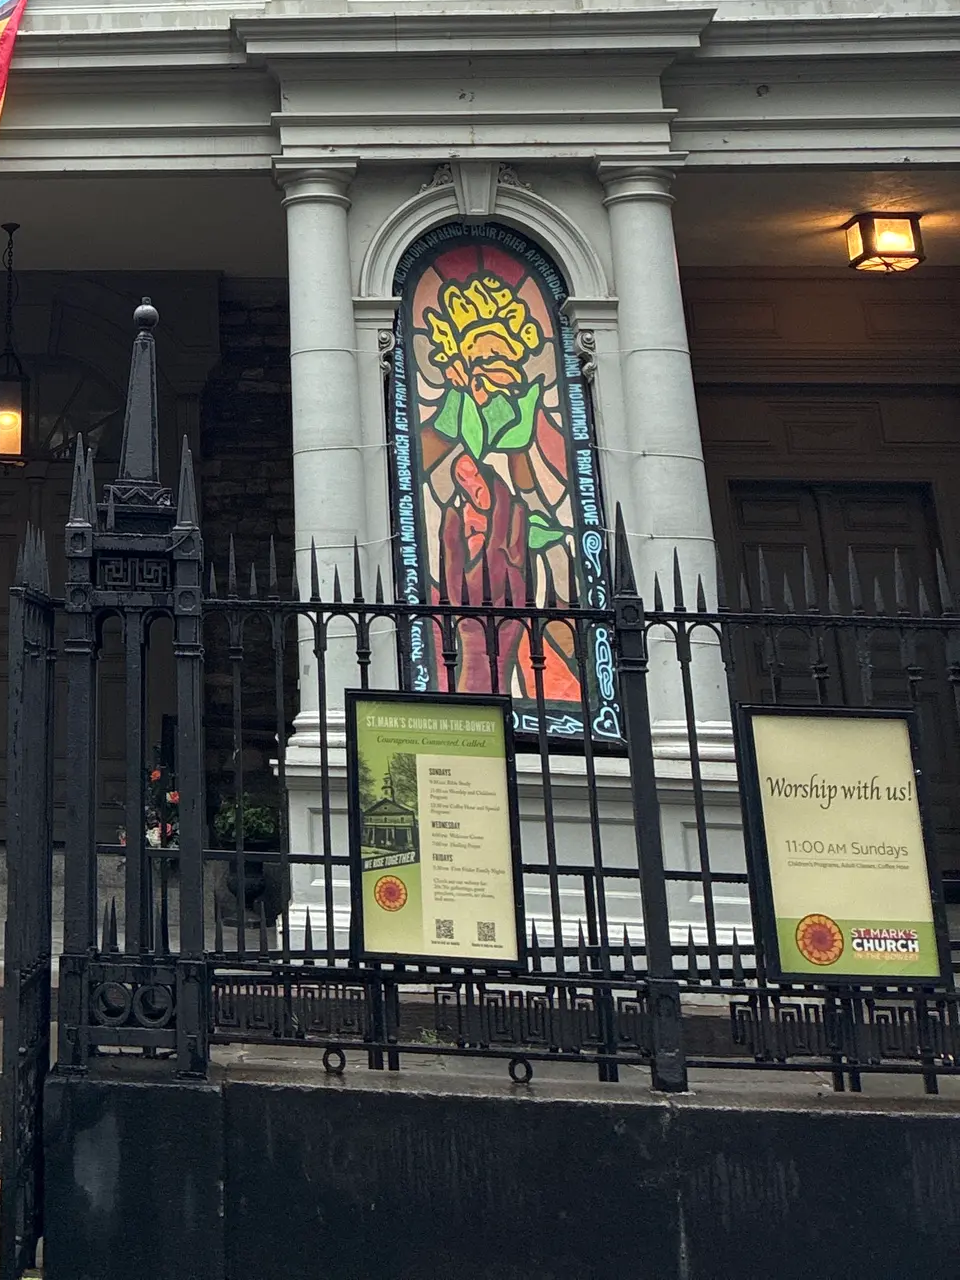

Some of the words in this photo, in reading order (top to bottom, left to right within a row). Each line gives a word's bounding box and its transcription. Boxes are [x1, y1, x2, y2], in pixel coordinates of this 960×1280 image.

[498, 230, 527, 253] PRIER
[525, 249, 566, 300] APPRENDRE
[394, 348, 406, 380] LEARN
[395, 380, 407, 408] PRAY
[395, 409, 408, 432] ACT
[576, 449, 592, 476] PRAY
[578, 477, 595, 498] ACT
[581, 499, 599, 526] LOVE
[408, 718, 438, 730] CHURCH
[428, 768, 451, 776] SUNDAYS
[767, 774, 838, 809] Worship
[841, 776, 881, 800] with
[886, 781, 912, 801] us!
[431, 821, 460, 829] WEDNESDAY
[385, 851, 415, 866] TOGETHER
[432, 853, 453, 862] FRIDAYS
[786, 840, 824, 853] 11:00
[827, 844, 846, 854] AM
[851, 842, 908, 858] Sundays
[870, 928, 918, 939] MARK'S
[852, 939, 919, 952] CHURCH
